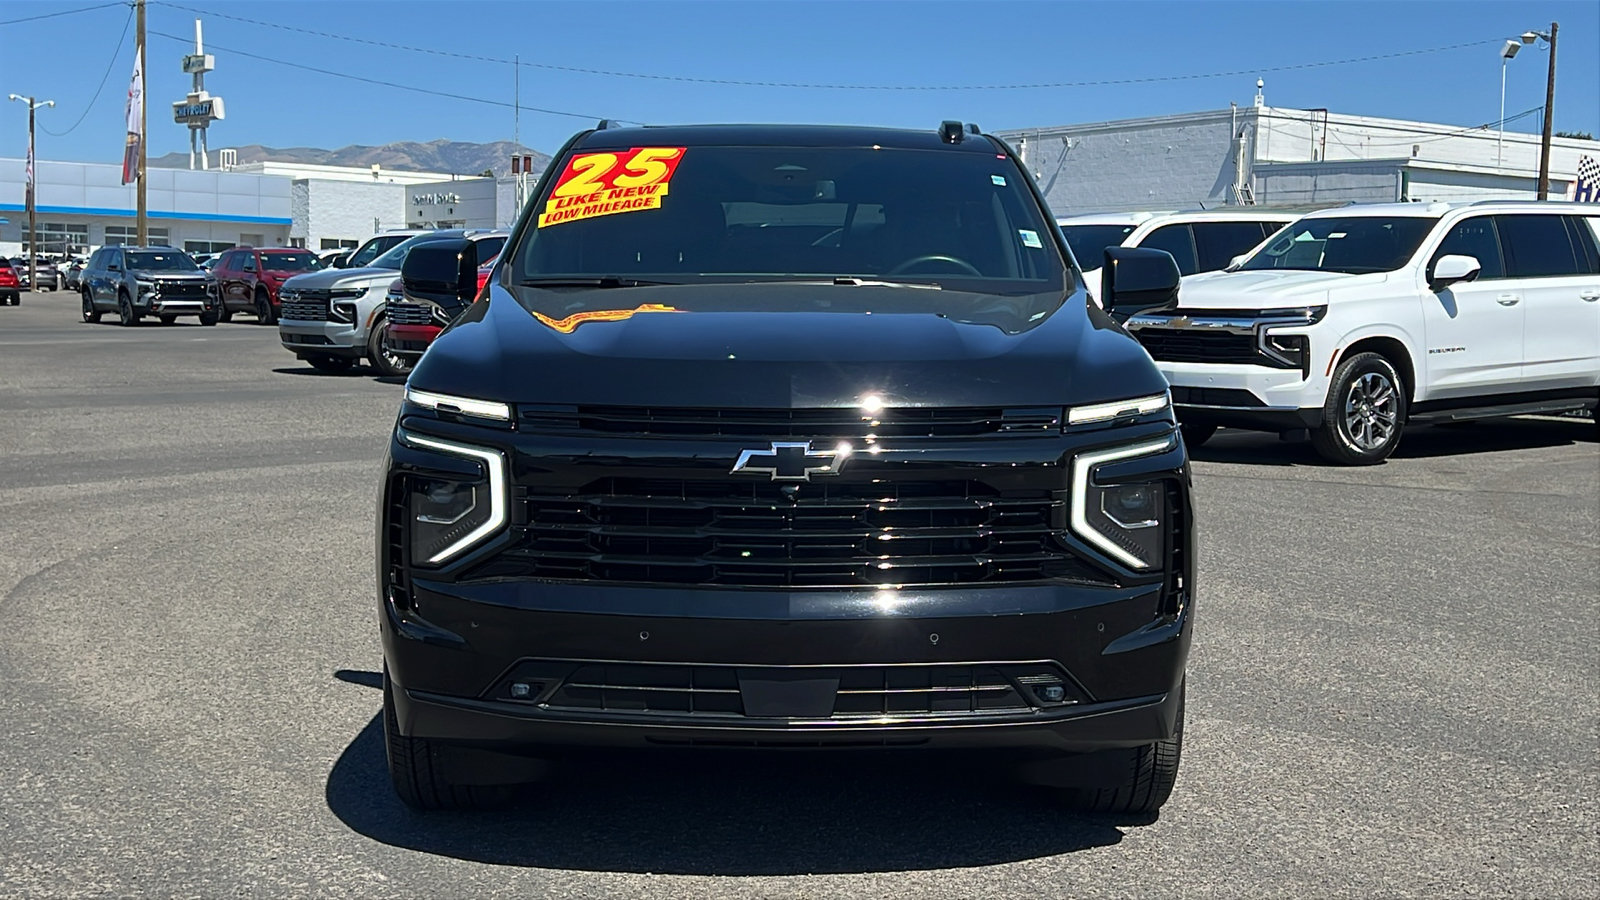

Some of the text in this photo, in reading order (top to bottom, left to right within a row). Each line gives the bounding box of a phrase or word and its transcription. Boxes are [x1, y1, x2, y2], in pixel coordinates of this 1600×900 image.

[554, 148, 680, 197] 25
[555, 185, 660, 209] LIKE NEW
[544, 198, 655, 224] LOW MILEAGE
